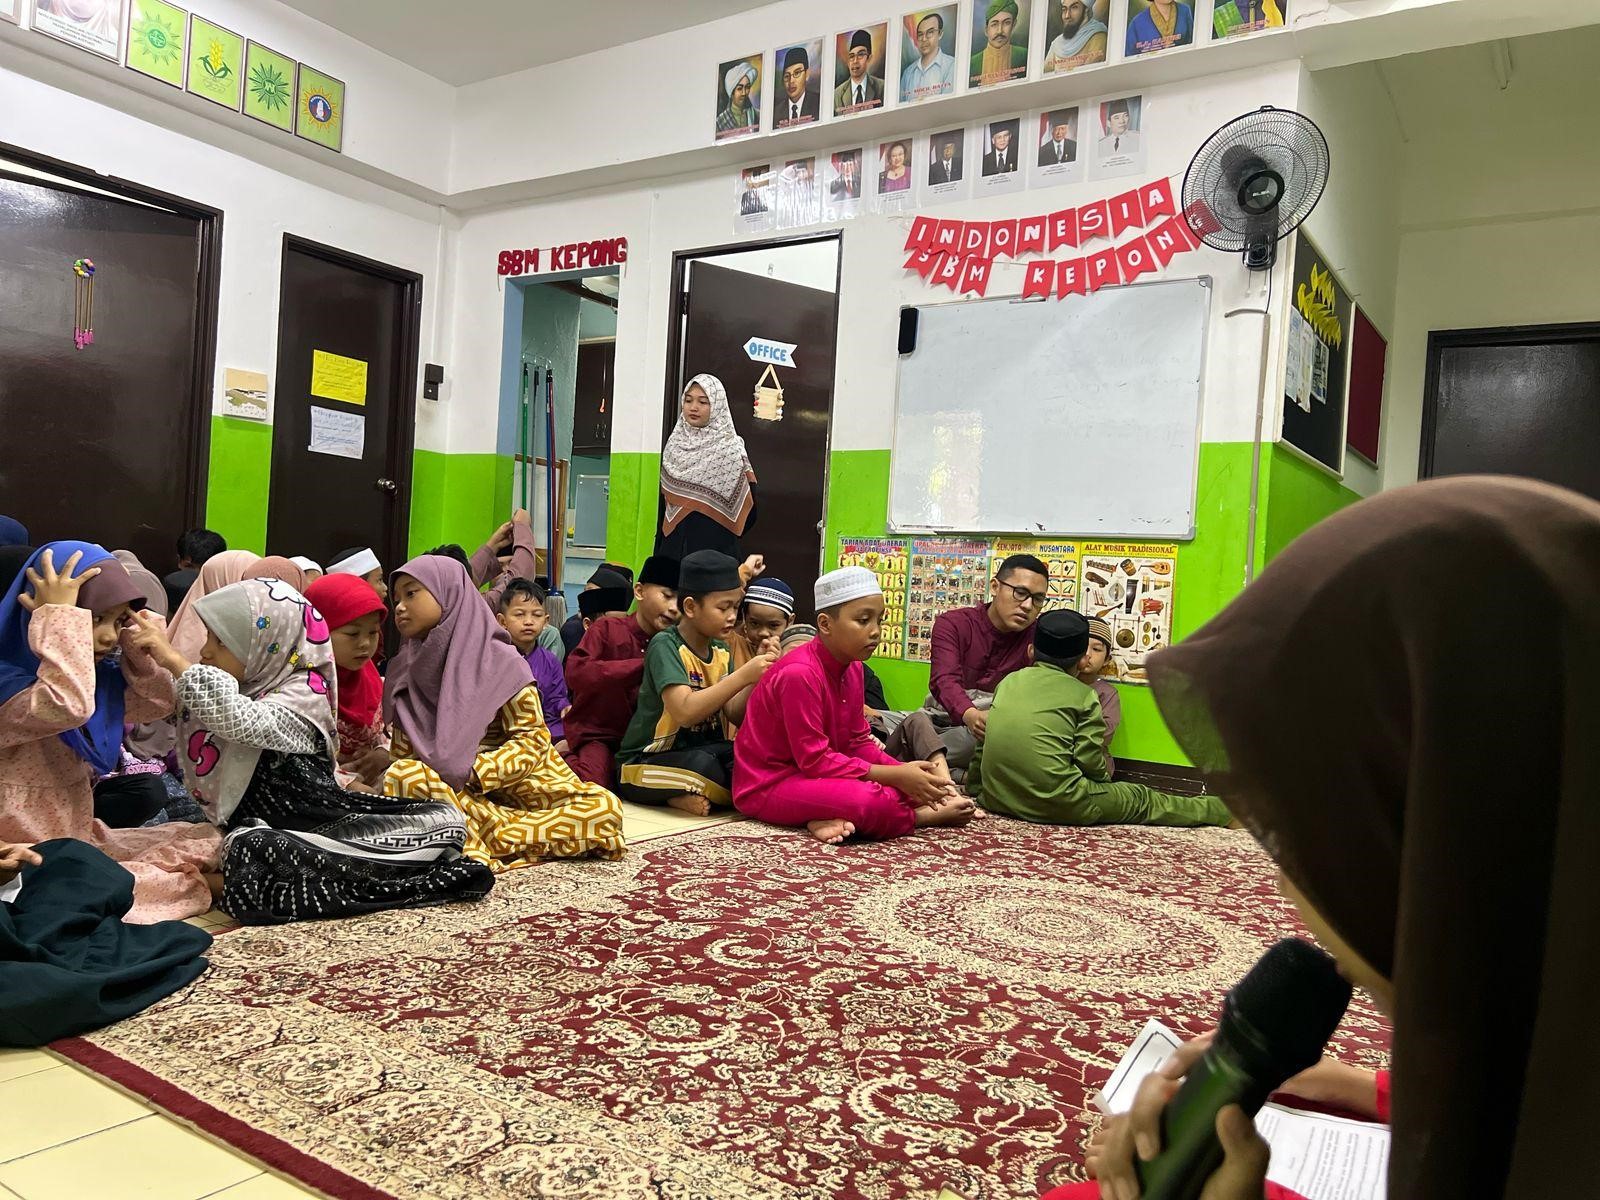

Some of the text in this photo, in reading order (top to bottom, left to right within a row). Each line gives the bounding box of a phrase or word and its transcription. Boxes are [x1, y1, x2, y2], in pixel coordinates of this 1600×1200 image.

[917, 188, 1165, 249] INDONESIA
[497, 237, 628, 276] SBM KEPONG
[749, 342, 787, 362] OFFICE
[996, 543, 1022, 551] SENJATA
[1040, 545, 1075, 553] NUSANTARA
[1127, 545, 1174, 554] TRADISIONAL
